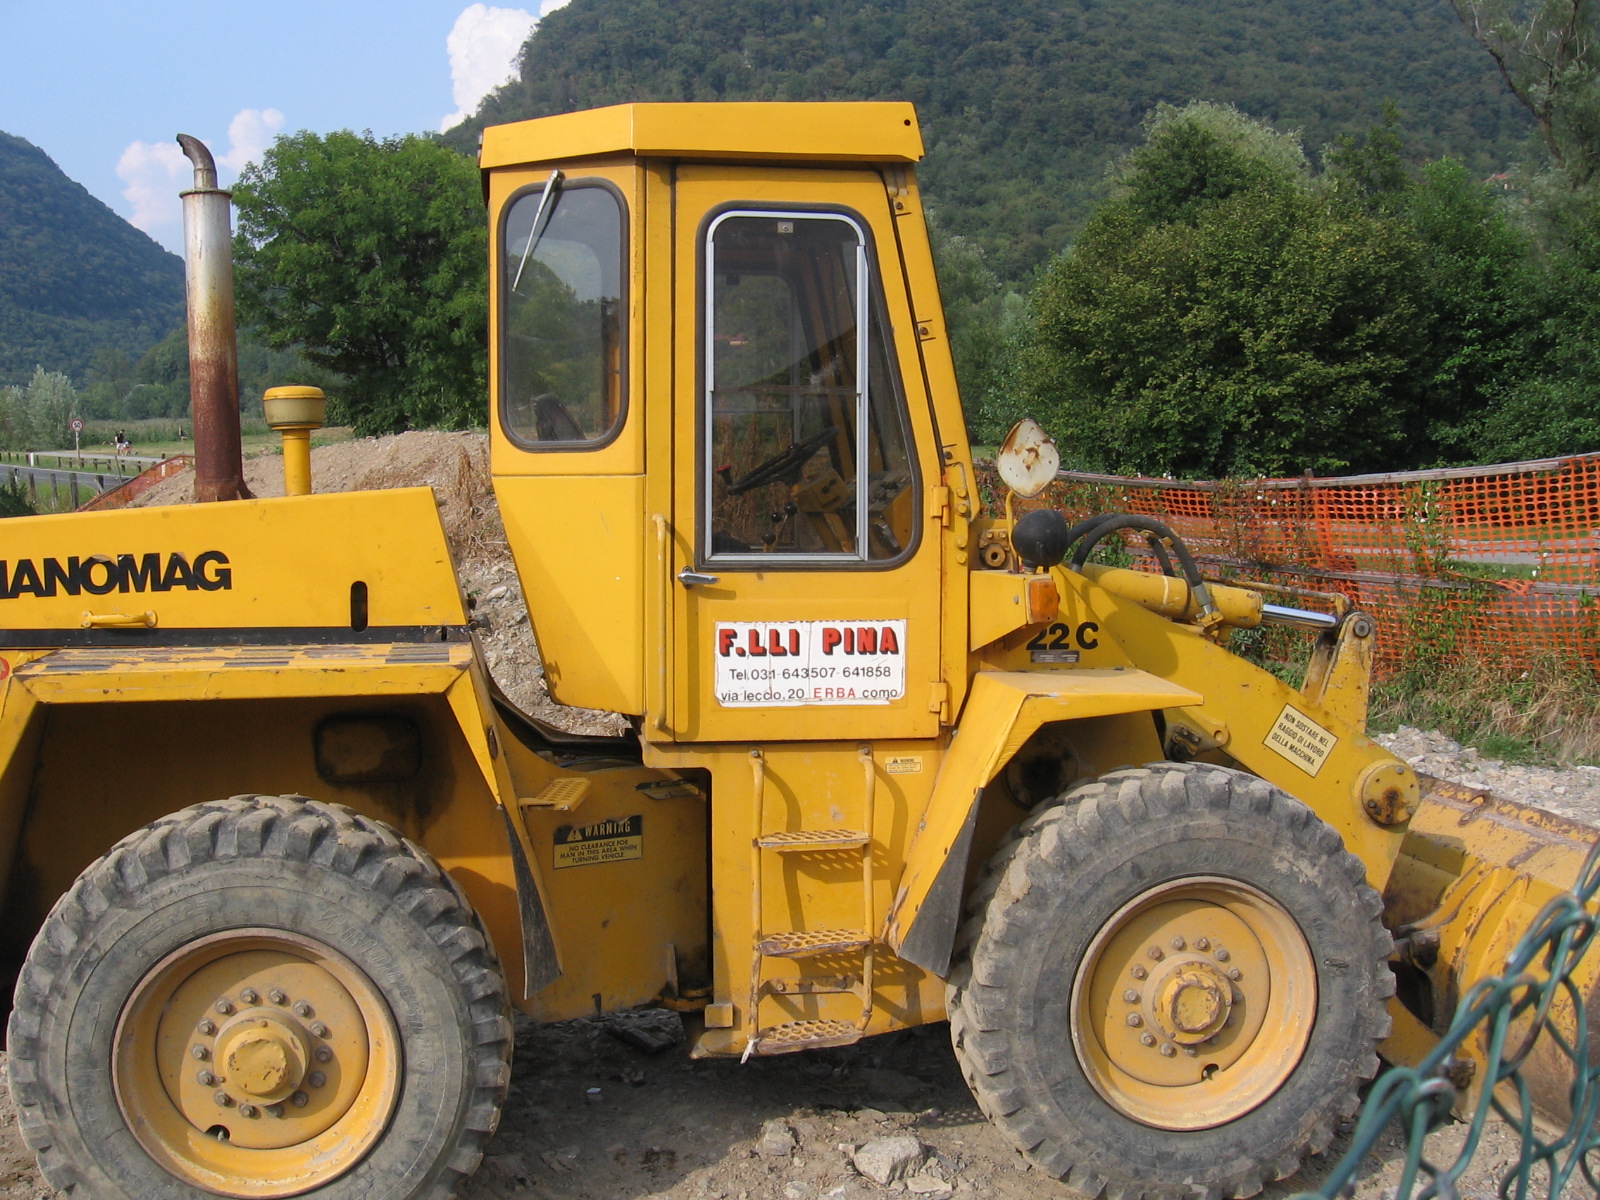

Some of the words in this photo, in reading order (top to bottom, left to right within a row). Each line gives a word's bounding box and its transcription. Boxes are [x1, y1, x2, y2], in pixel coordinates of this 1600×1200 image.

[0, 550, 232, 599] ANOMAG
[822, 627, 900, 655] PINA
[721, 690, 739, 701] via
[813, 687, 856, 699] ERBA
[1284, 713, 1295, 724] NON
[1295, 720, 1318, 740] SOSTARE
[1319, 736, 1329, 747] NEL
[1271, 732, 1289, 748] DELLA
[1278, 722, 1298, 740] RAGGIO
[1303, 742, 1324, 757] LAVORO
[585, 820, 631, 837] WARNING
[580, 841, 616, 850] CLEARANCE
[571, 855, 599, 864] TURNING
